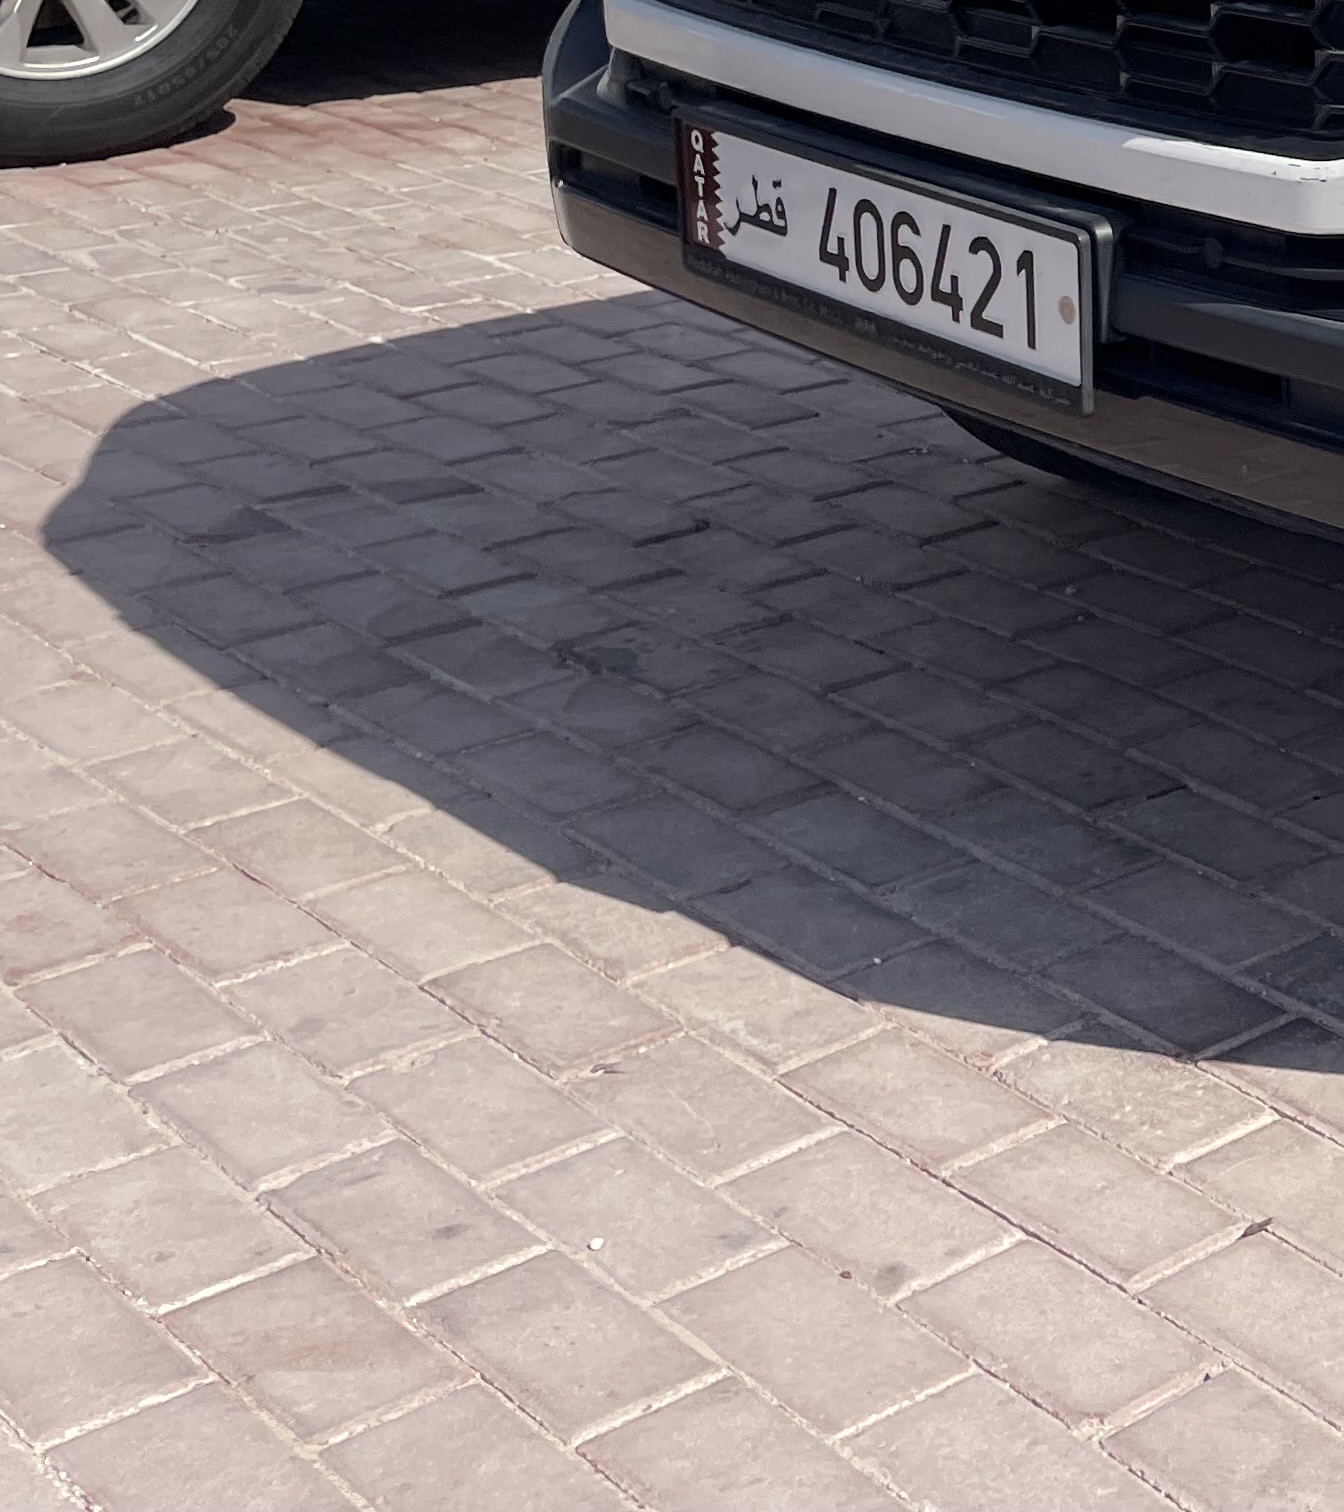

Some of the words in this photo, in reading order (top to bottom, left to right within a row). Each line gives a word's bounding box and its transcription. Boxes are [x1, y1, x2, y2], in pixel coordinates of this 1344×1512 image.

[690, 129, 711, 244] QATAR
[723, 174, 789, 238] قطر
[819, 187, 1037, 350] 406421
